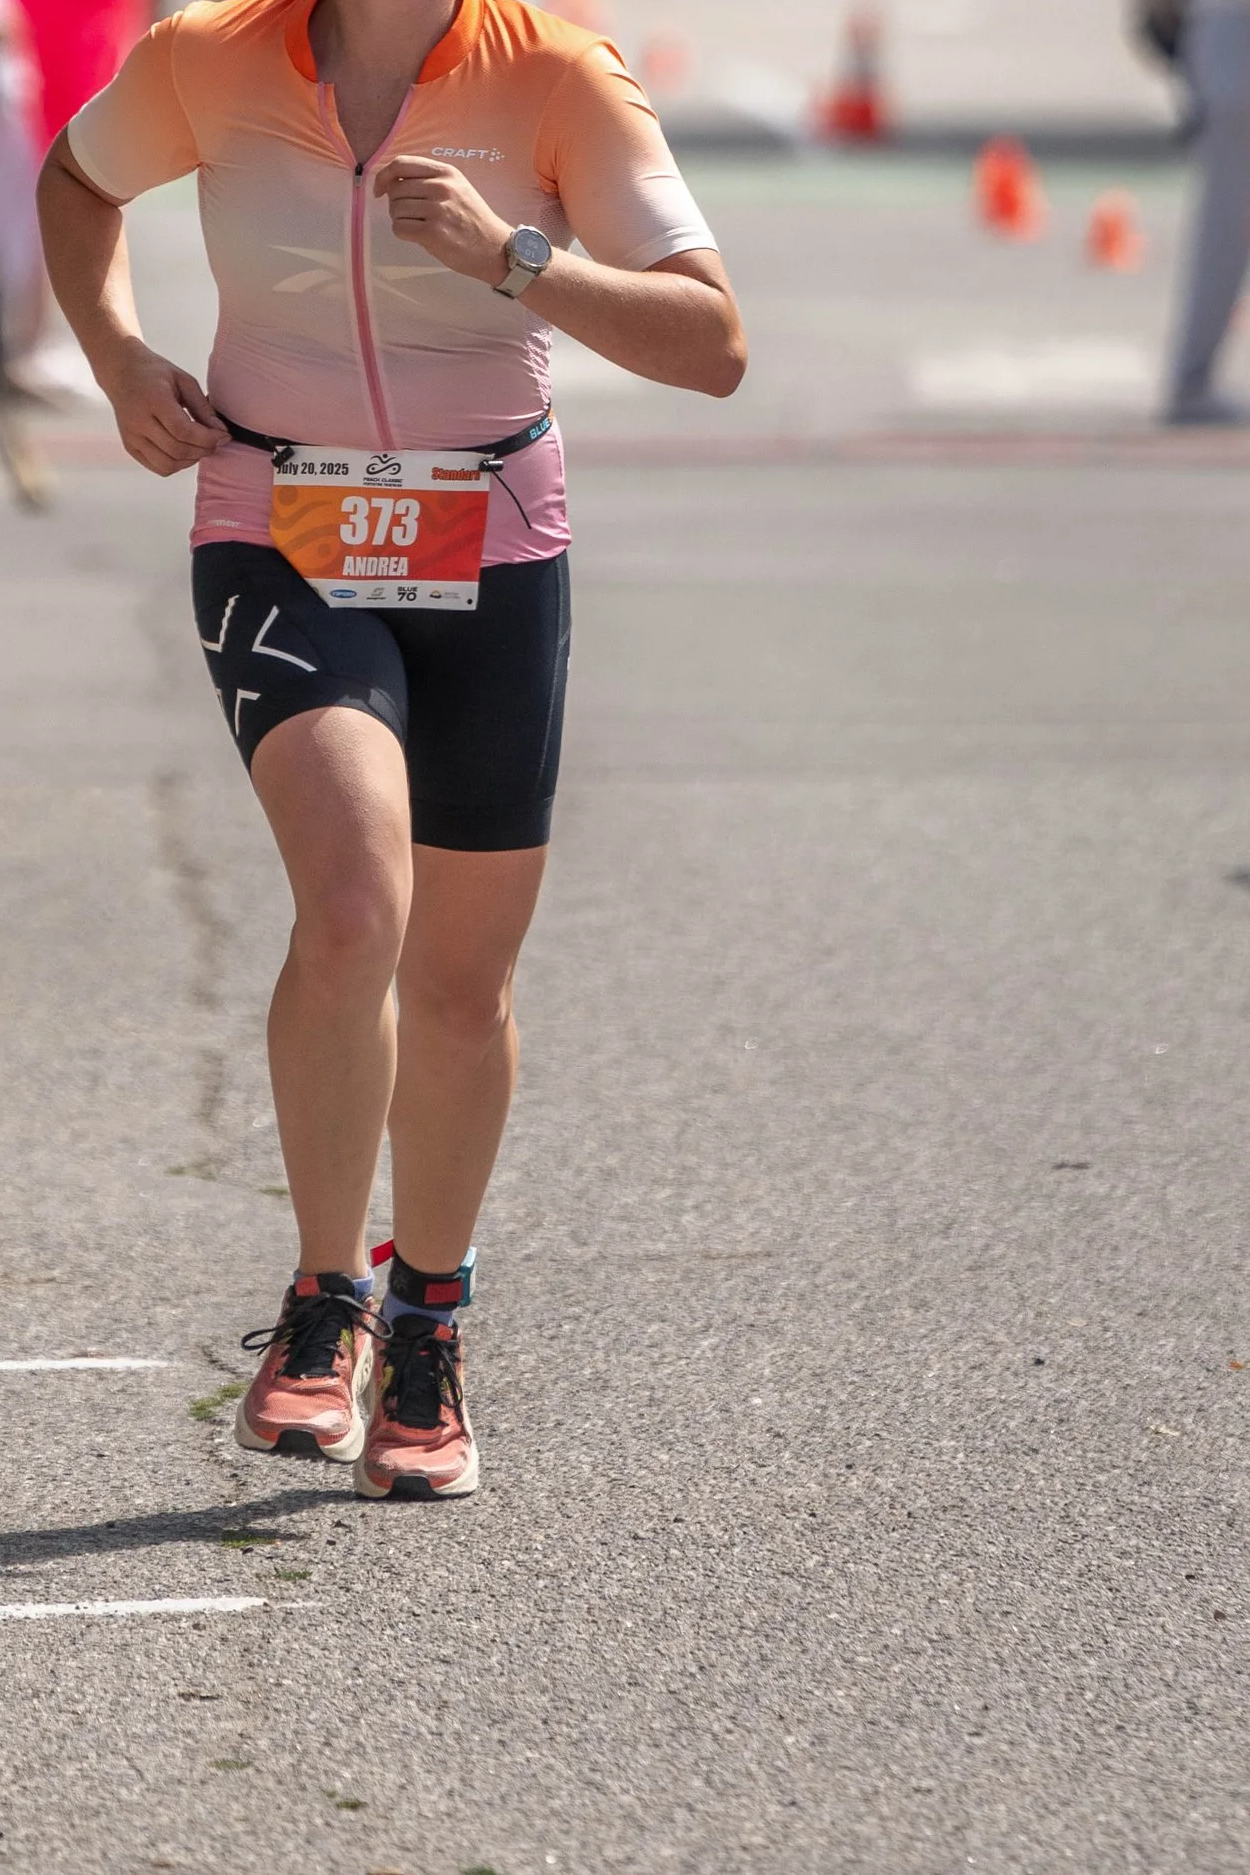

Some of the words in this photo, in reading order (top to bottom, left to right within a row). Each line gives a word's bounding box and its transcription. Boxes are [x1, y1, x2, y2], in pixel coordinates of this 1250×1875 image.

[431, 147, 488, 159] CRAFT
[301, 462, 317, 475] 20,
[319, 463, 349, 475] 2025
[339, 496, 421, 546] 373
[342, 555, 409, 576] ANDREA
[397, 592, 417, 602] 70
